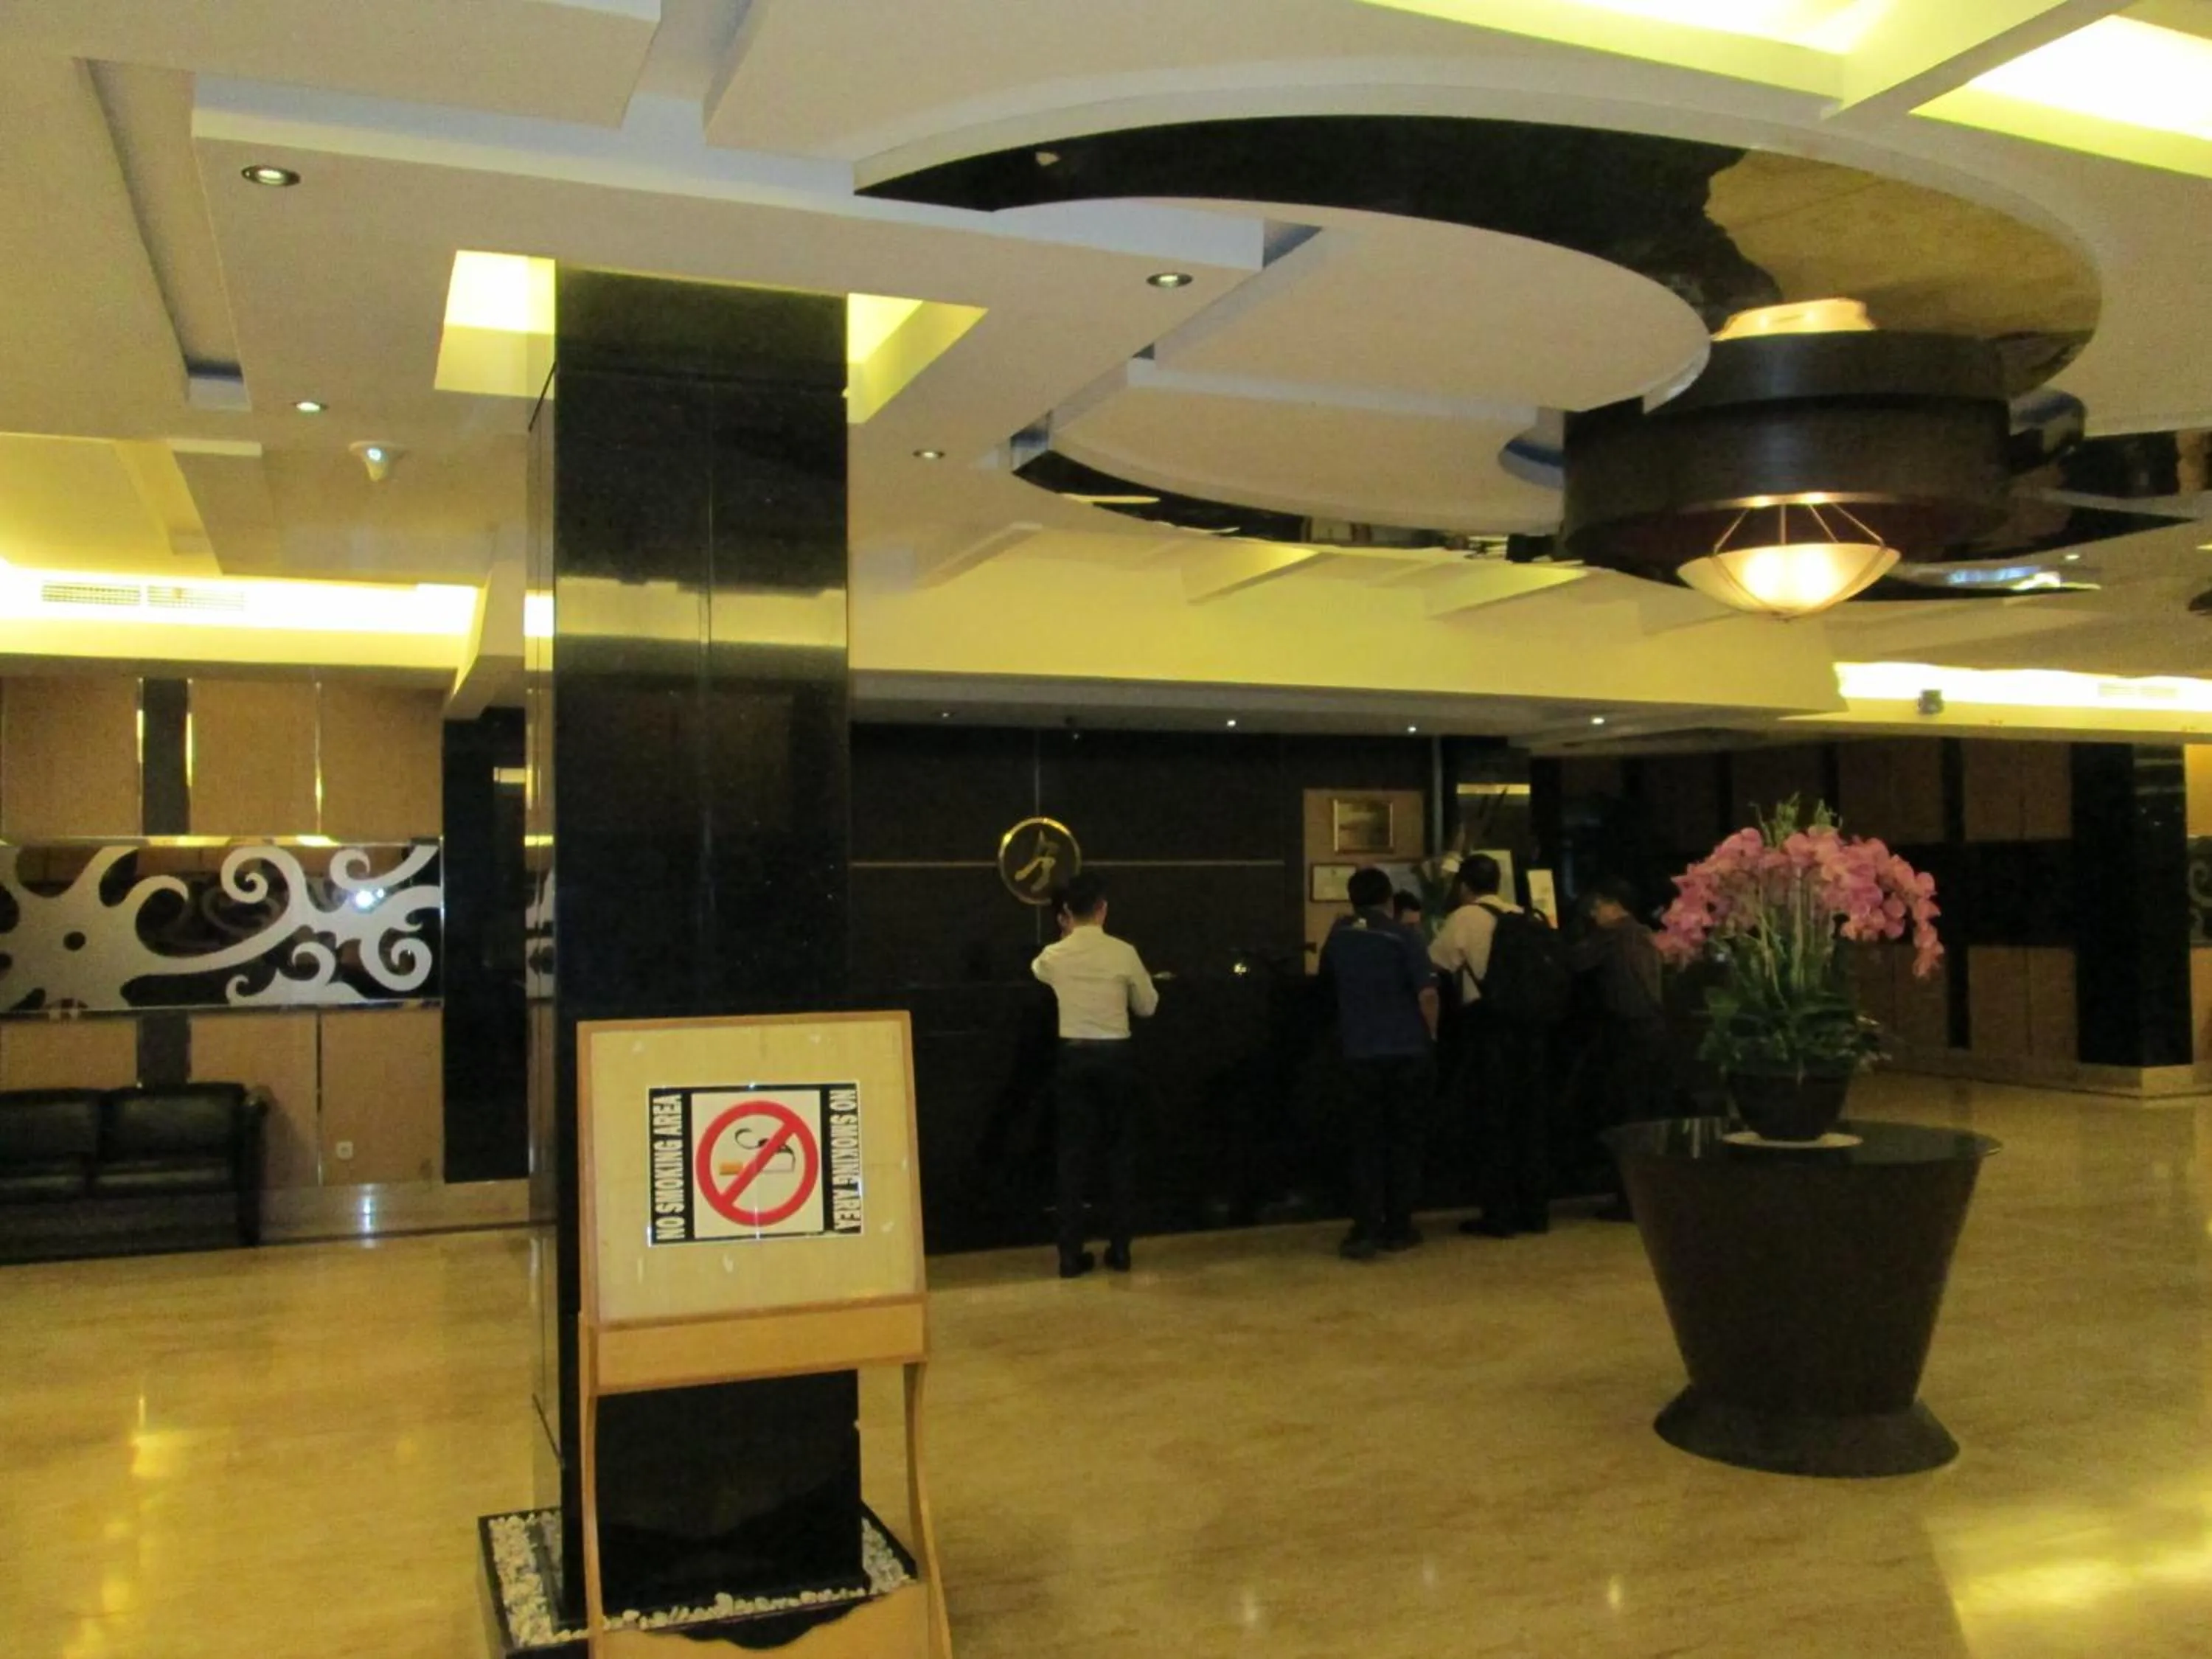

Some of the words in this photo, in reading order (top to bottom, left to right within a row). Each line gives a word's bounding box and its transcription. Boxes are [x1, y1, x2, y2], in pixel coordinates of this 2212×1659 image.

[653, 1094, 681, 1135] AREA
[830, 1089, 856, 1111] NO
[830, 1114, 859, 1186] SMOKING
[653, 1140, 684, 1213] SMOKING
[655, 1217, 685, 1240] NO
[833, 1189, 861, 1230] AREA
